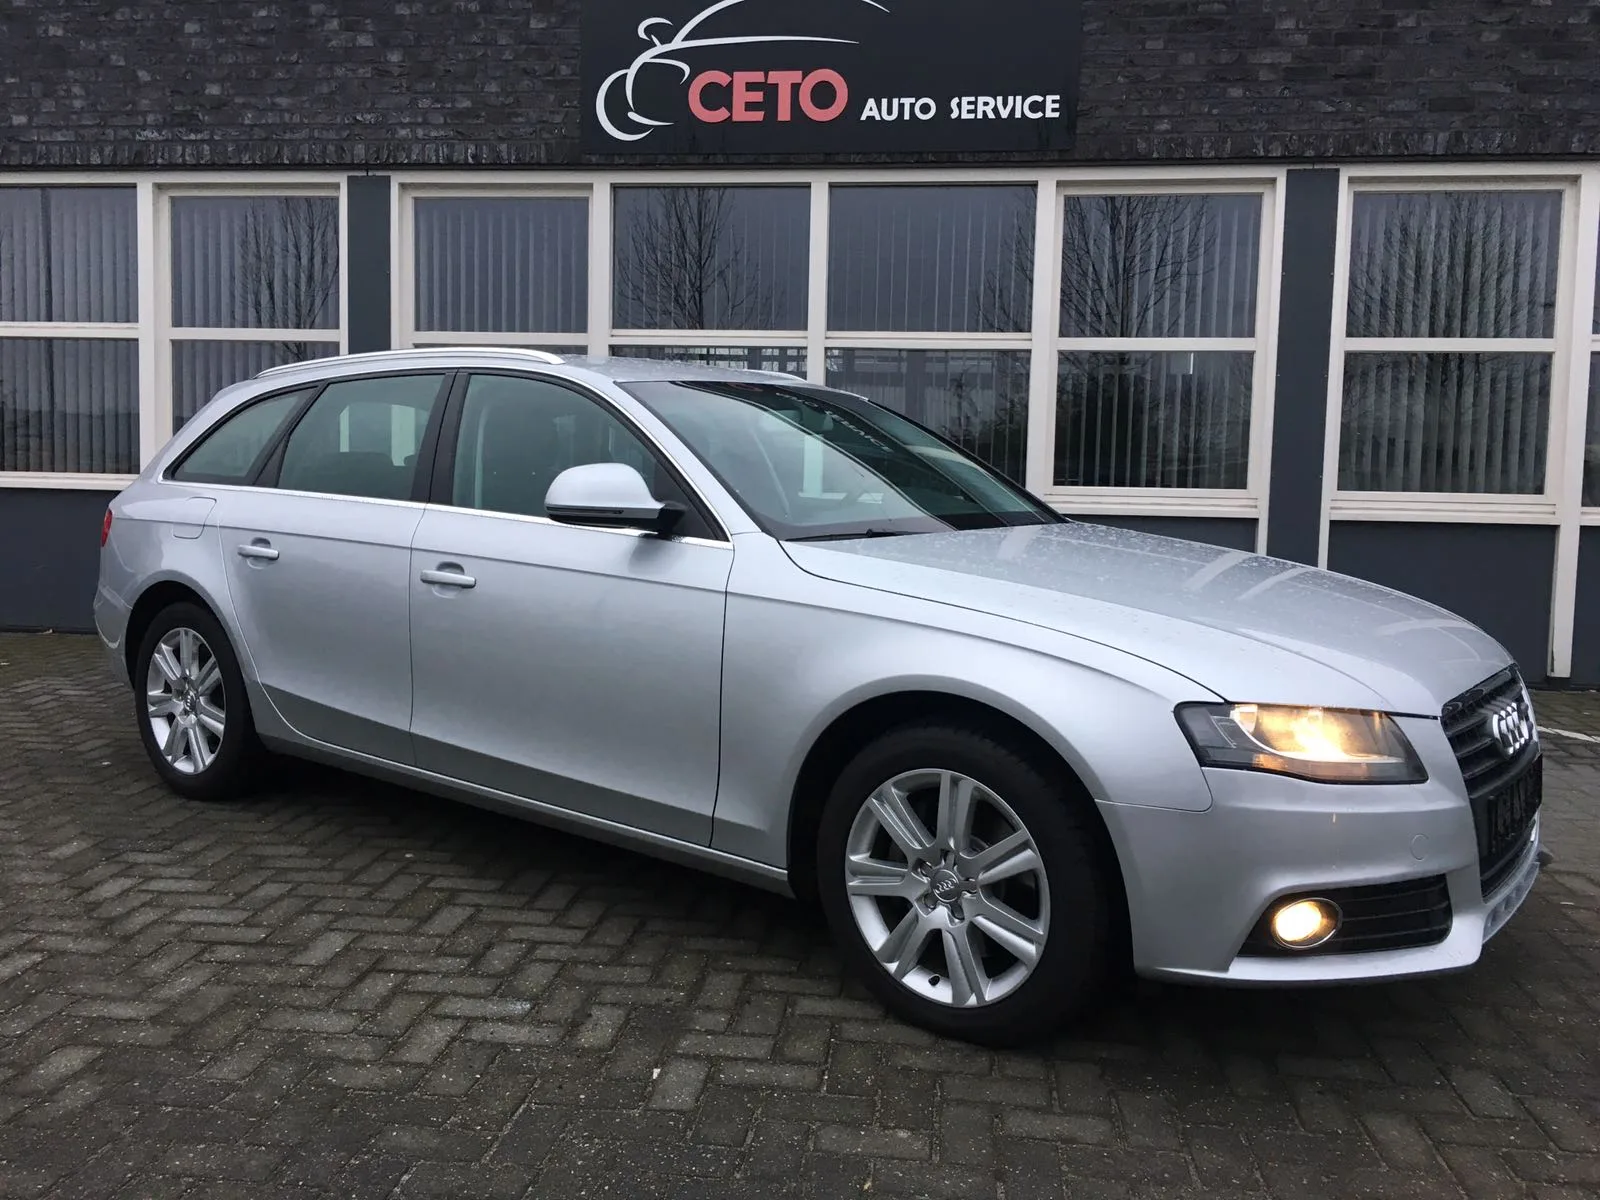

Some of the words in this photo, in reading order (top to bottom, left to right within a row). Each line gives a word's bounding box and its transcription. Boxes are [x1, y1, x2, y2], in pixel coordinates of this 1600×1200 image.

[688, 69, 848, 122] CETO
[860, 97, 937, 121] AUTO
[950, 94, 1061, 120] SERVICE
